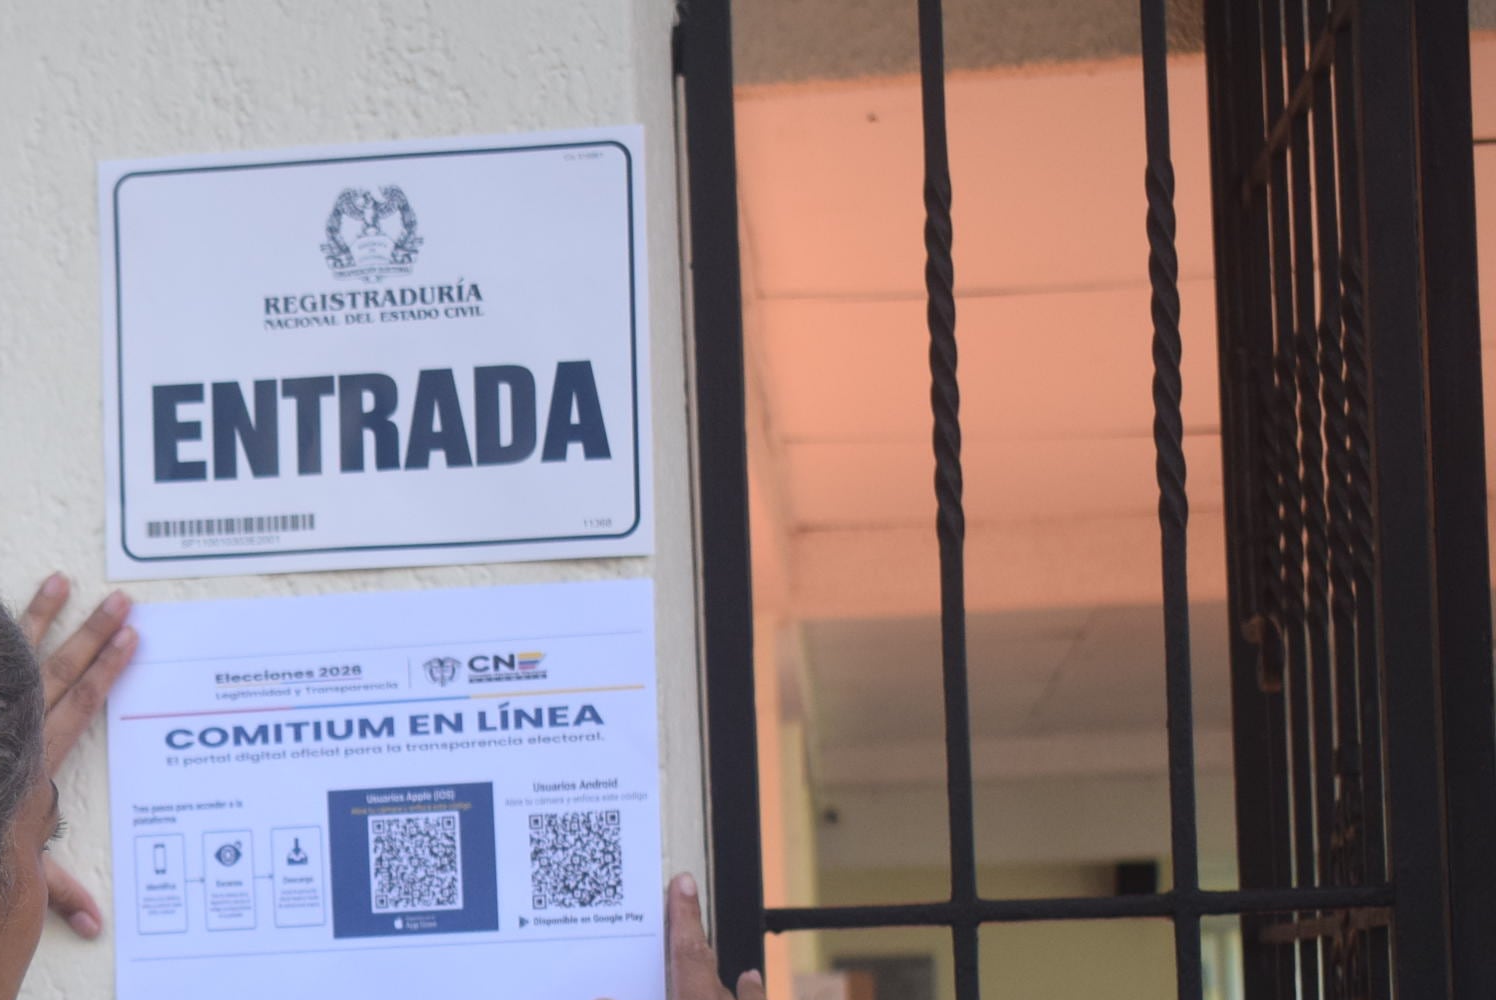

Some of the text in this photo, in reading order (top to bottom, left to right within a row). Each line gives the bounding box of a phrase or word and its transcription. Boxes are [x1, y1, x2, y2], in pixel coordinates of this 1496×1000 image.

[263, 278, 483, 316] REGISTRADURÍA
[264, 305, 484, 331] NACIONAL DEL ESTADO CIVIL
[151, 359, 612, 484] ENTRADA
[215, 669, 314, 684] Elecciones
[165, 701, 605, 750] COMITIUM EN LÍNEA
[183, 753, 231, 767] portal
[235, 750, 287, 764] digital
[344, 746, 382, 758] para
[387, 742, 401, 753] la
[405, 738, 523, 752] transparencia
[533, 779, 618, 793] Usuarios Android
